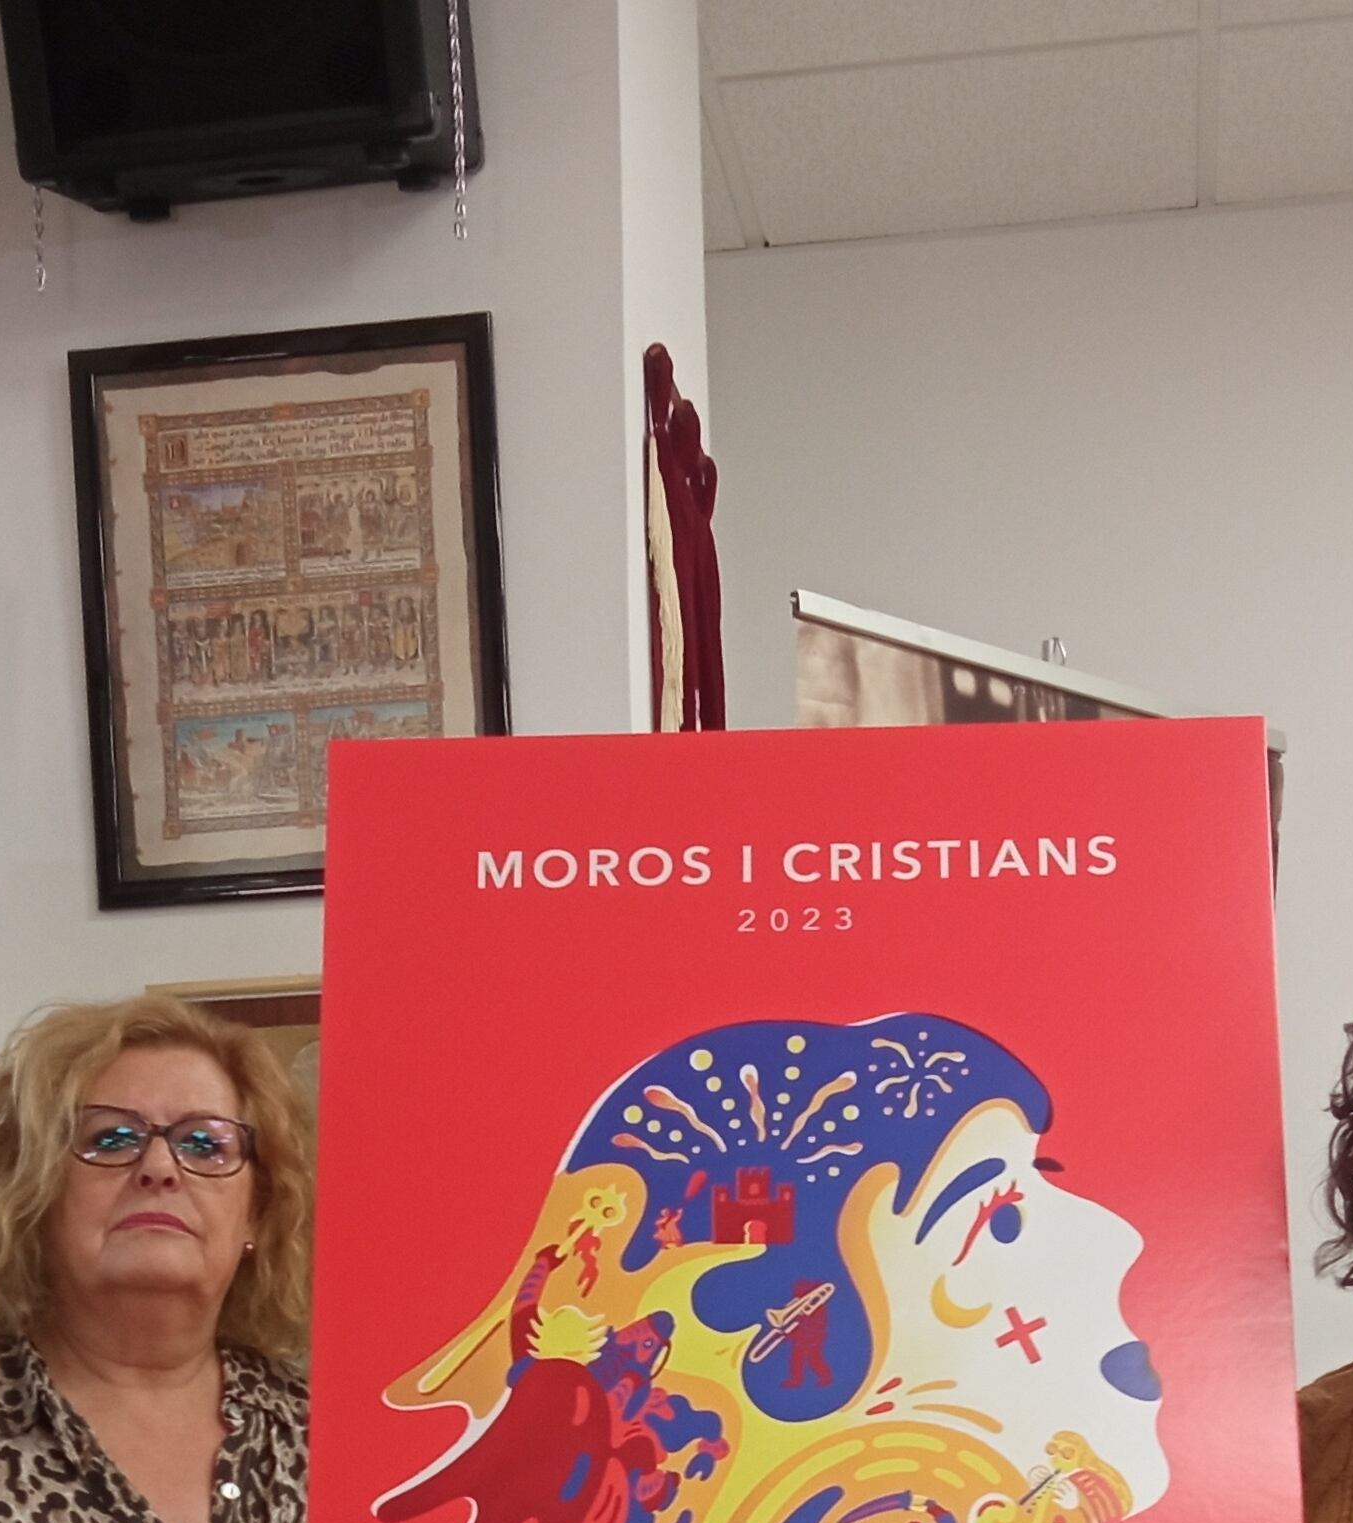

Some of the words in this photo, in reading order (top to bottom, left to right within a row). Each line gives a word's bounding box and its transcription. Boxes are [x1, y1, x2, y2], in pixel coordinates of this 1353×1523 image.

[476, 845, 712, 889] MOROS
[742, 845, 753, 883] I
[783, 835, 1118, 883] CRISTIANS
[737, 907, 854, 932] 2023
